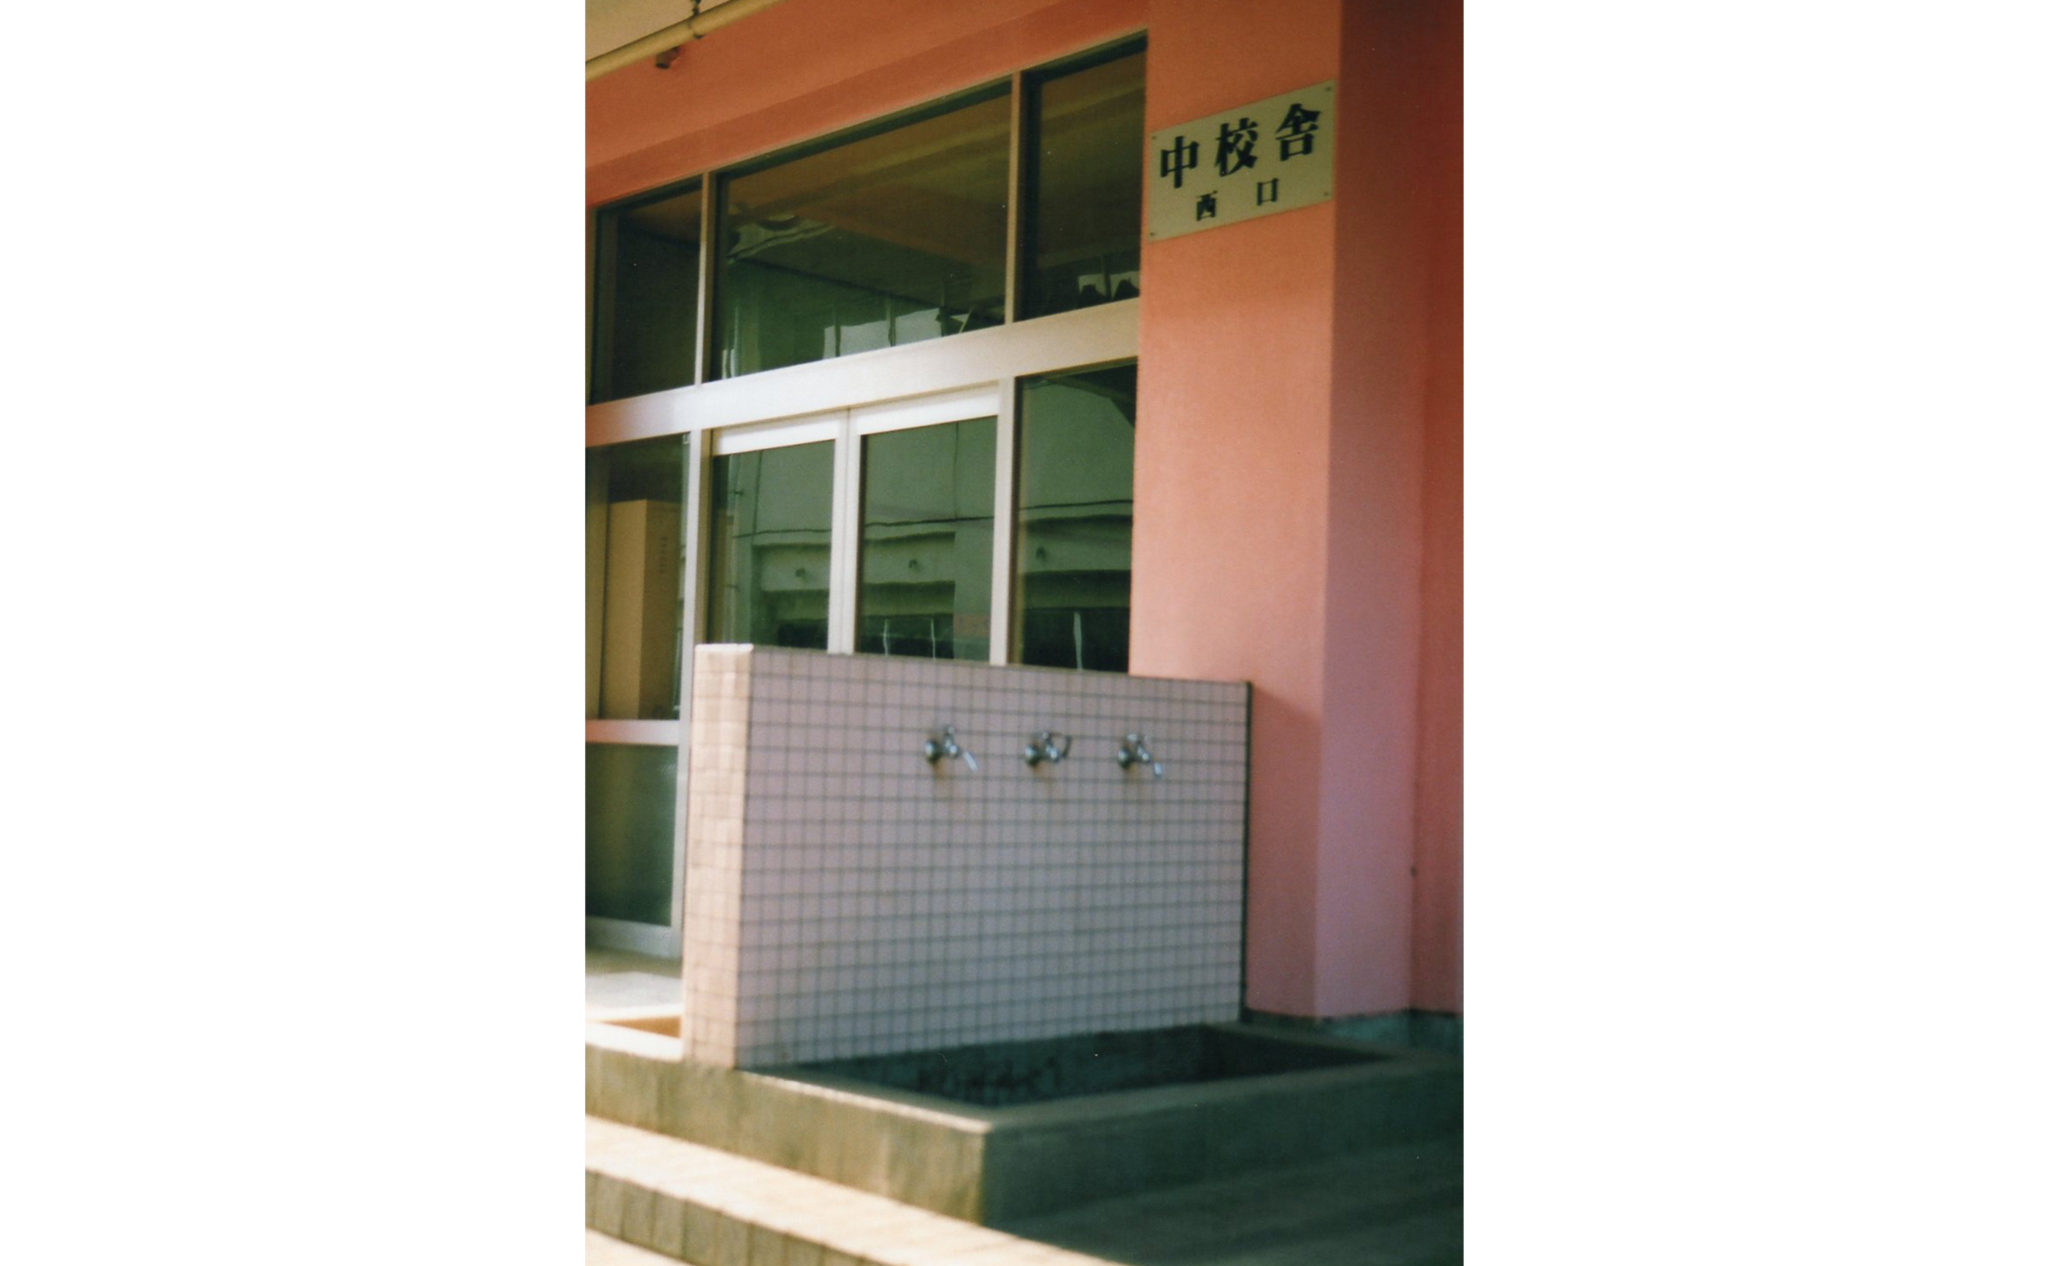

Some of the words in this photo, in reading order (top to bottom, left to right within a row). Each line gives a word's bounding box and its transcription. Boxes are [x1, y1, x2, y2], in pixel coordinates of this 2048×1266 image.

[1160, 103, 1321, 189] 中校舎
[1196, 178, 1279, 221] 西口
